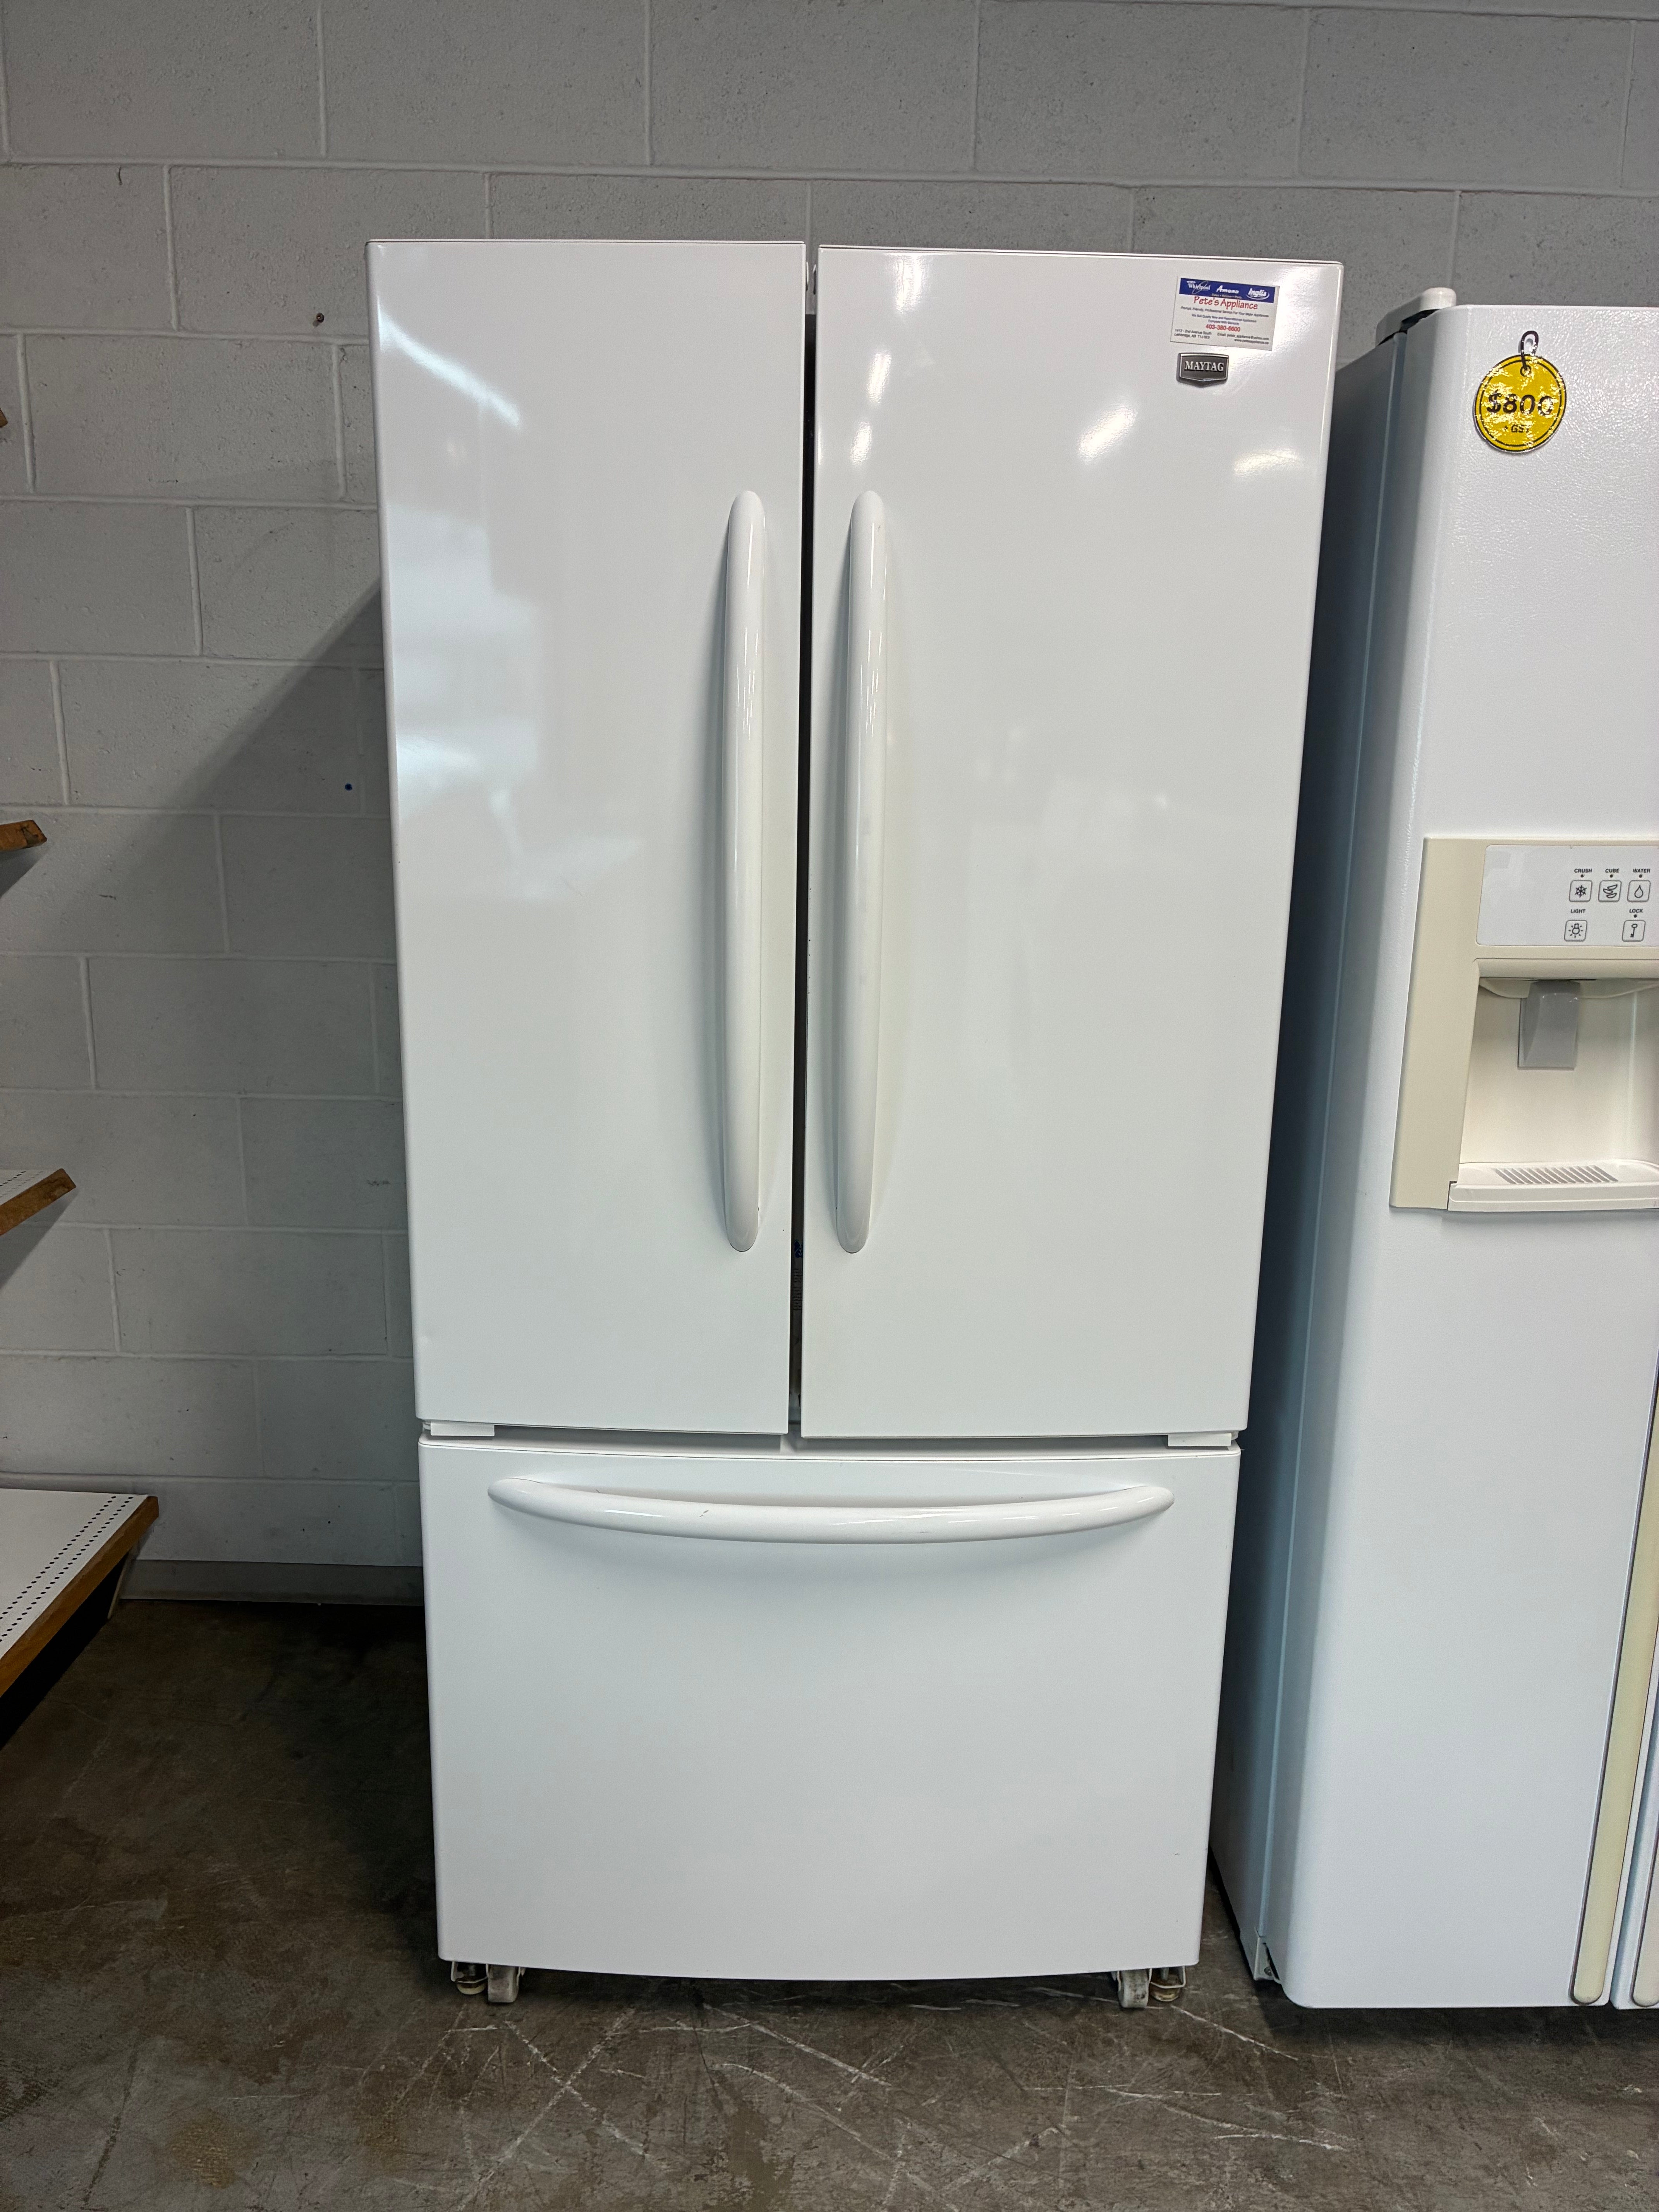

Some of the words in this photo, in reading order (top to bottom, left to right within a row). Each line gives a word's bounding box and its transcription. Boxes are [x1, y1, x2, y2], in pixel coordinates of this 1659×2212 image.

[1216, 285, 1239, 294] Amana
[1194, 296, 1219, 306] Pete's
[1220, 299, 1258, 310] Appliance
[1184, 361, 1224, 372] MAYTAG
[1486, 389, 1554, 416] $800
